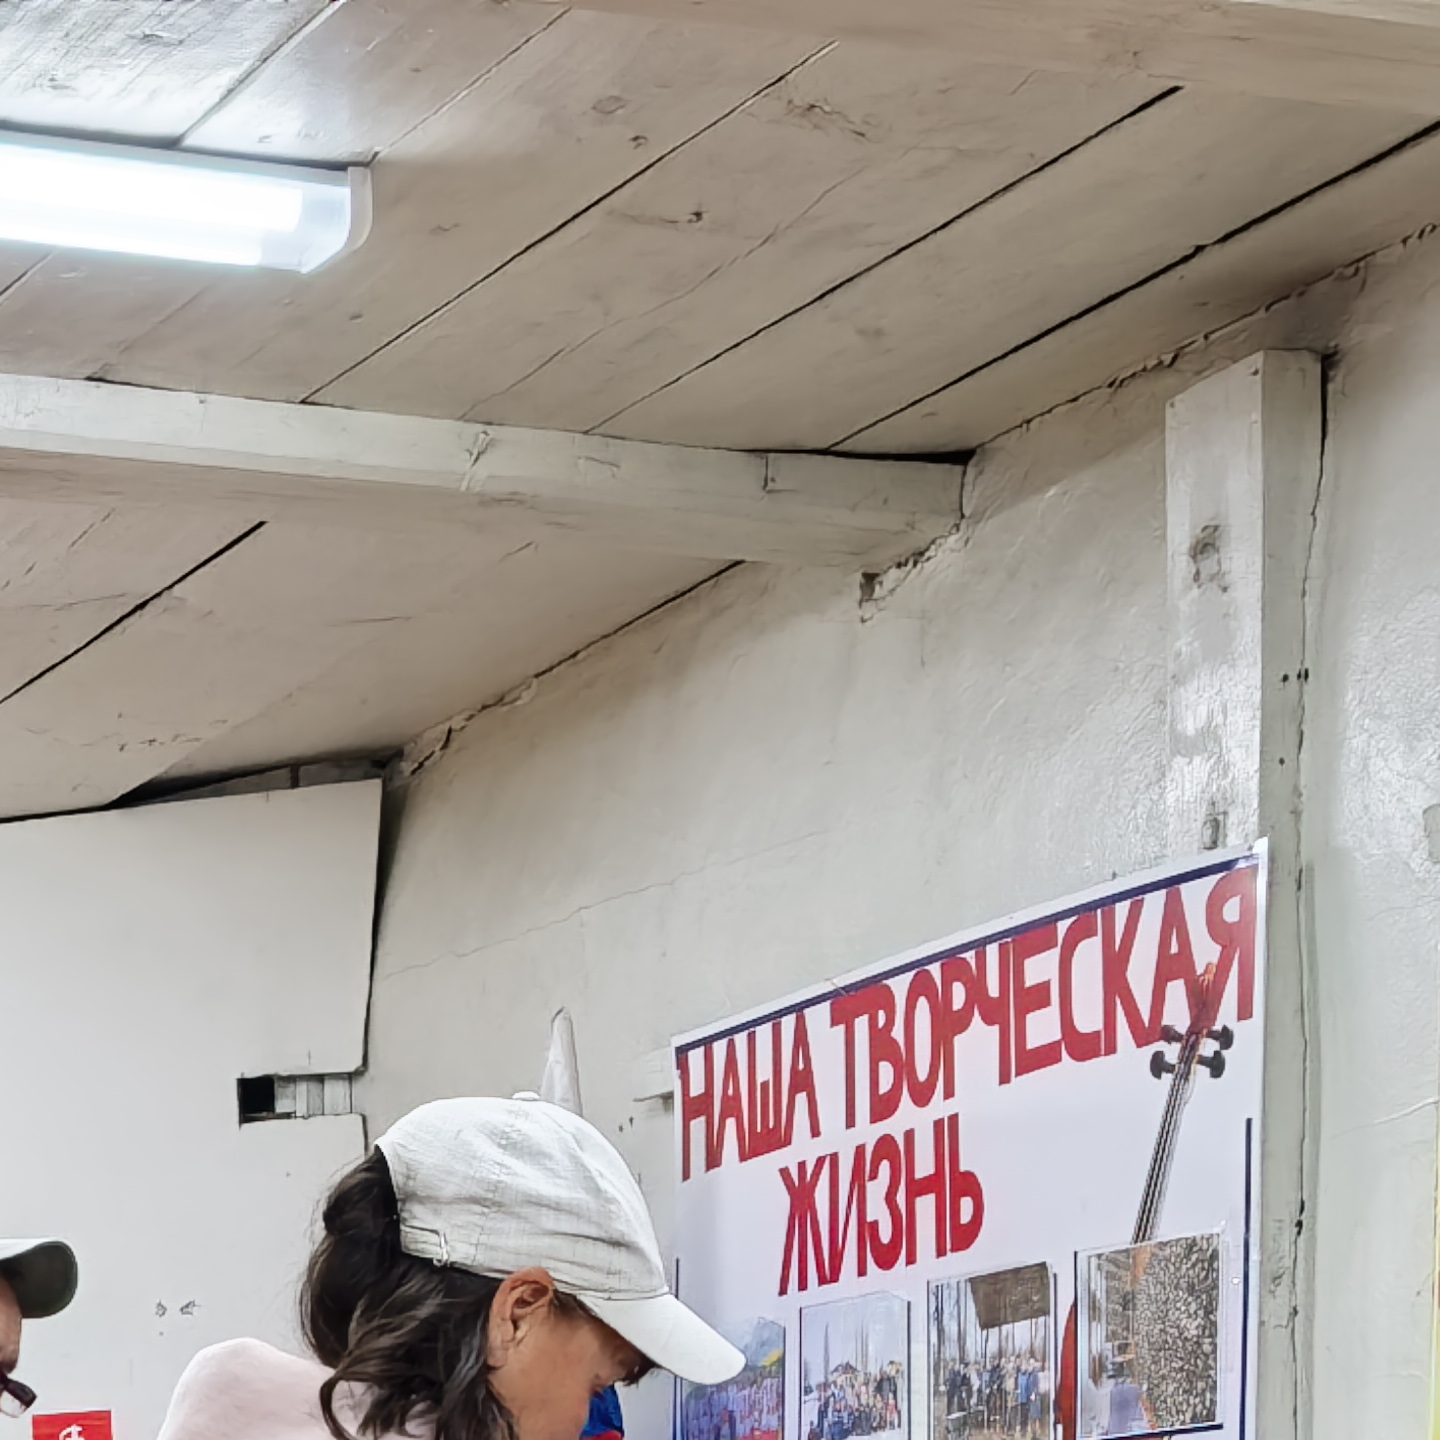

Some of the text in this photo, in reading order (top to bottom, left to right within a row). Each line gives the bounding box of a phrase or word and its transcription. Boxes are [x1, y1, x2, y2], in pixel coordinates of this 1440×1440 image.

[677, 865, 1259, 1183] НАША ТВОРЧЕСКАЯ
[779, 1113, 984, 1296] ЖИЗНЬ
